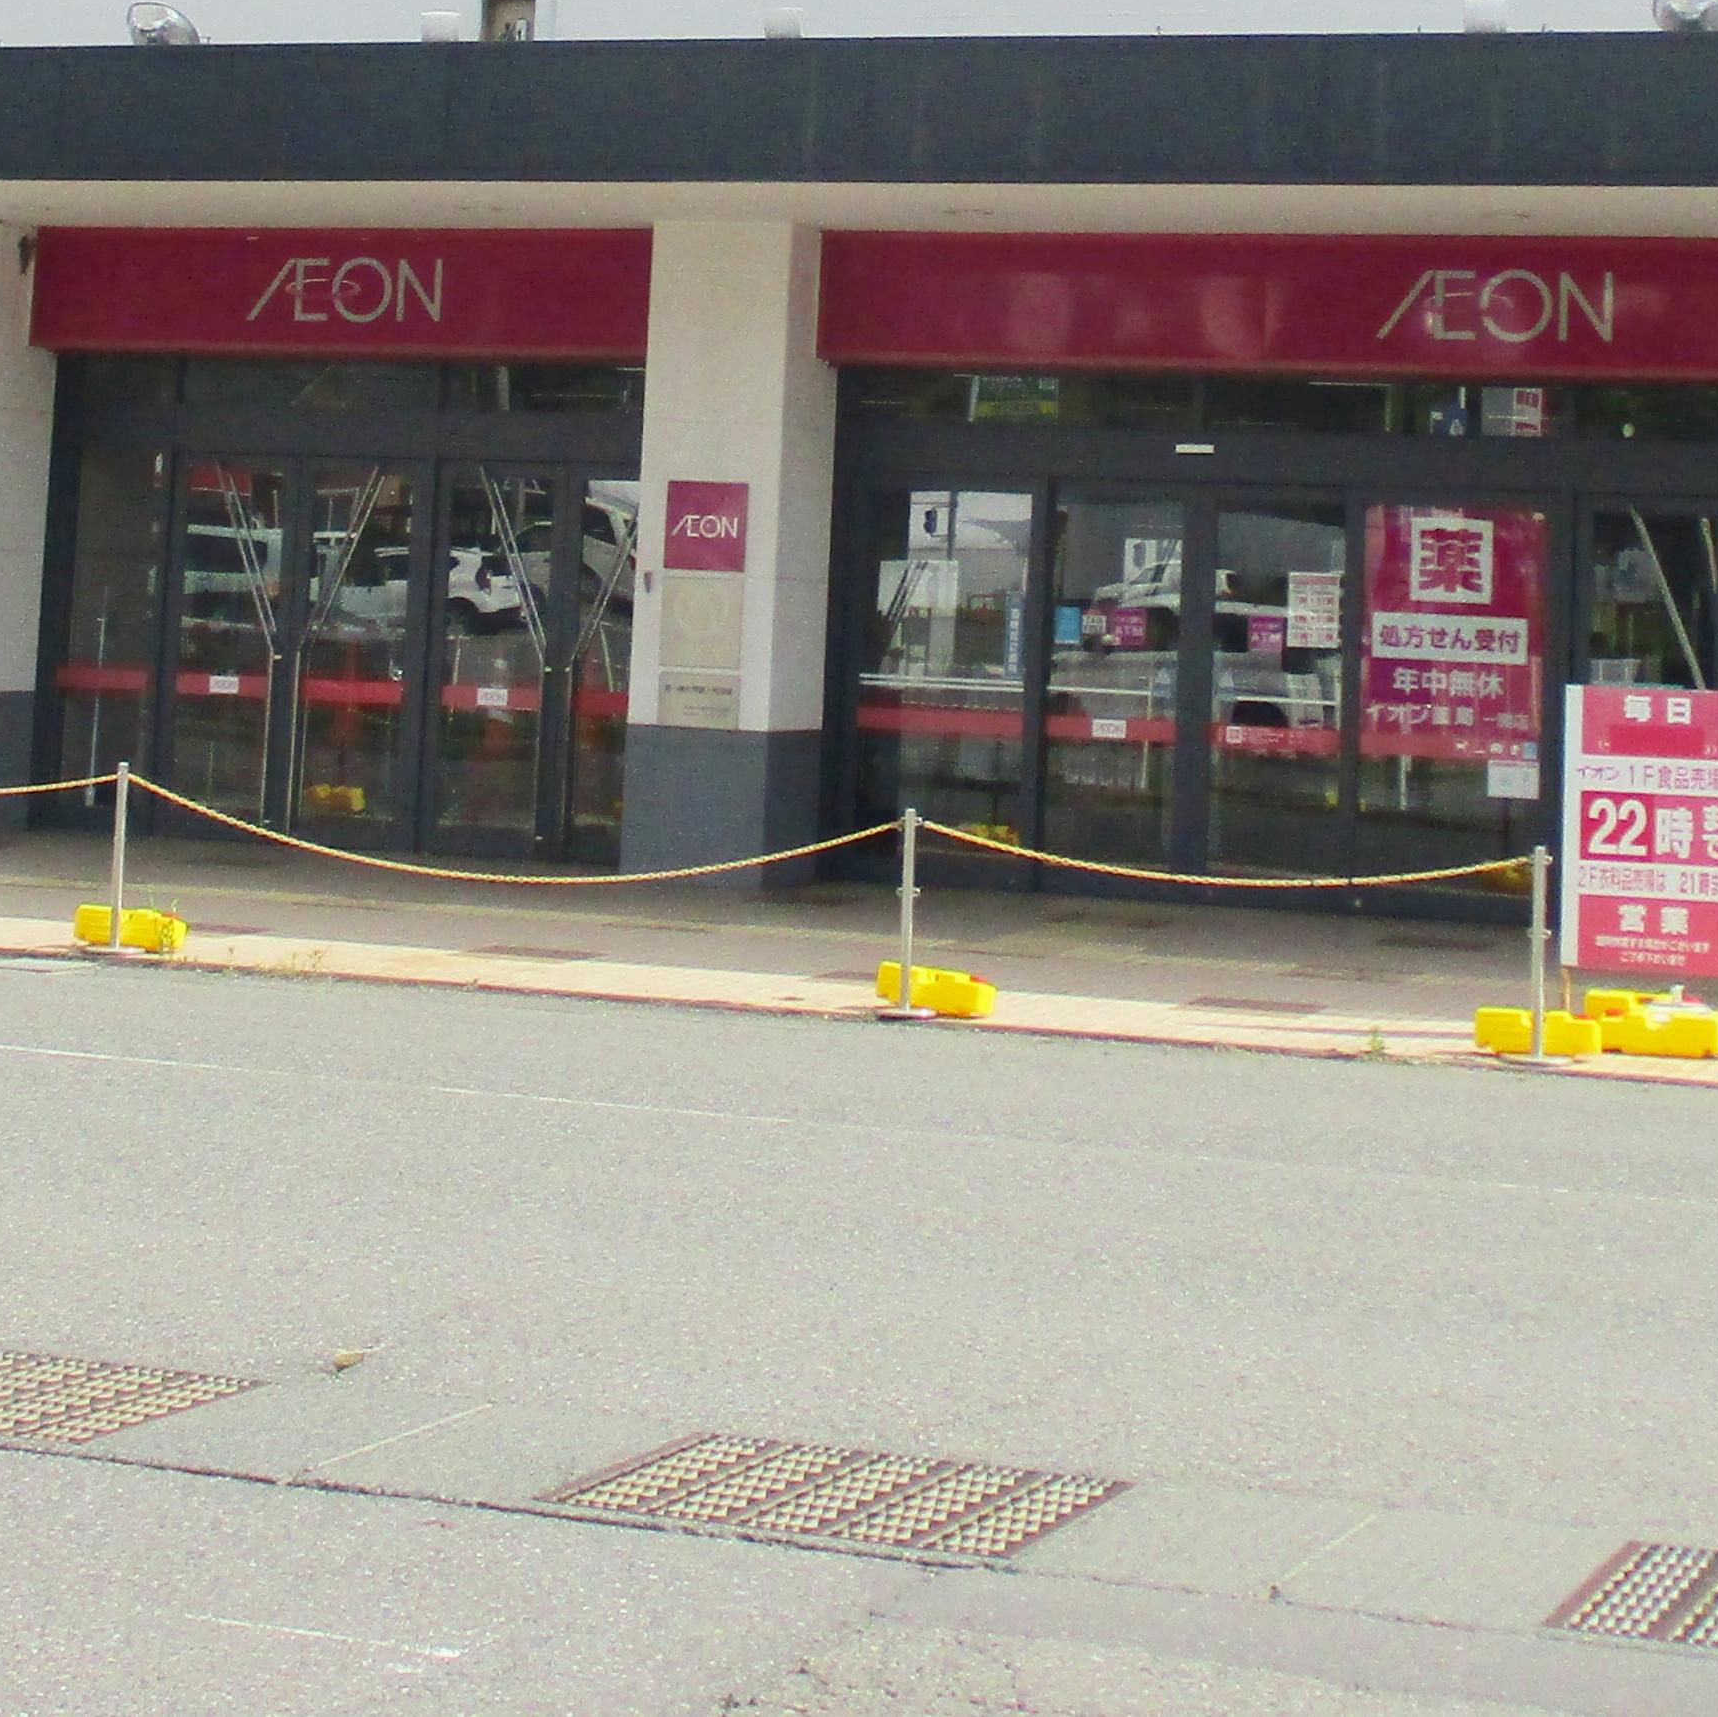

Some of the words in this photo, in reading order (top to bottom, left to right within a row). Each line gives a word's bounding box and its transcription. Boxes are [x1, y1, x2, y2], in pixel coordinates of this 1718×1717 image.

[1380, 625, 1520, 653] 処方せん受付
[1392, 667, 1505, 699] 年中無休
[1623, 695, 1692, 725] 毎日
